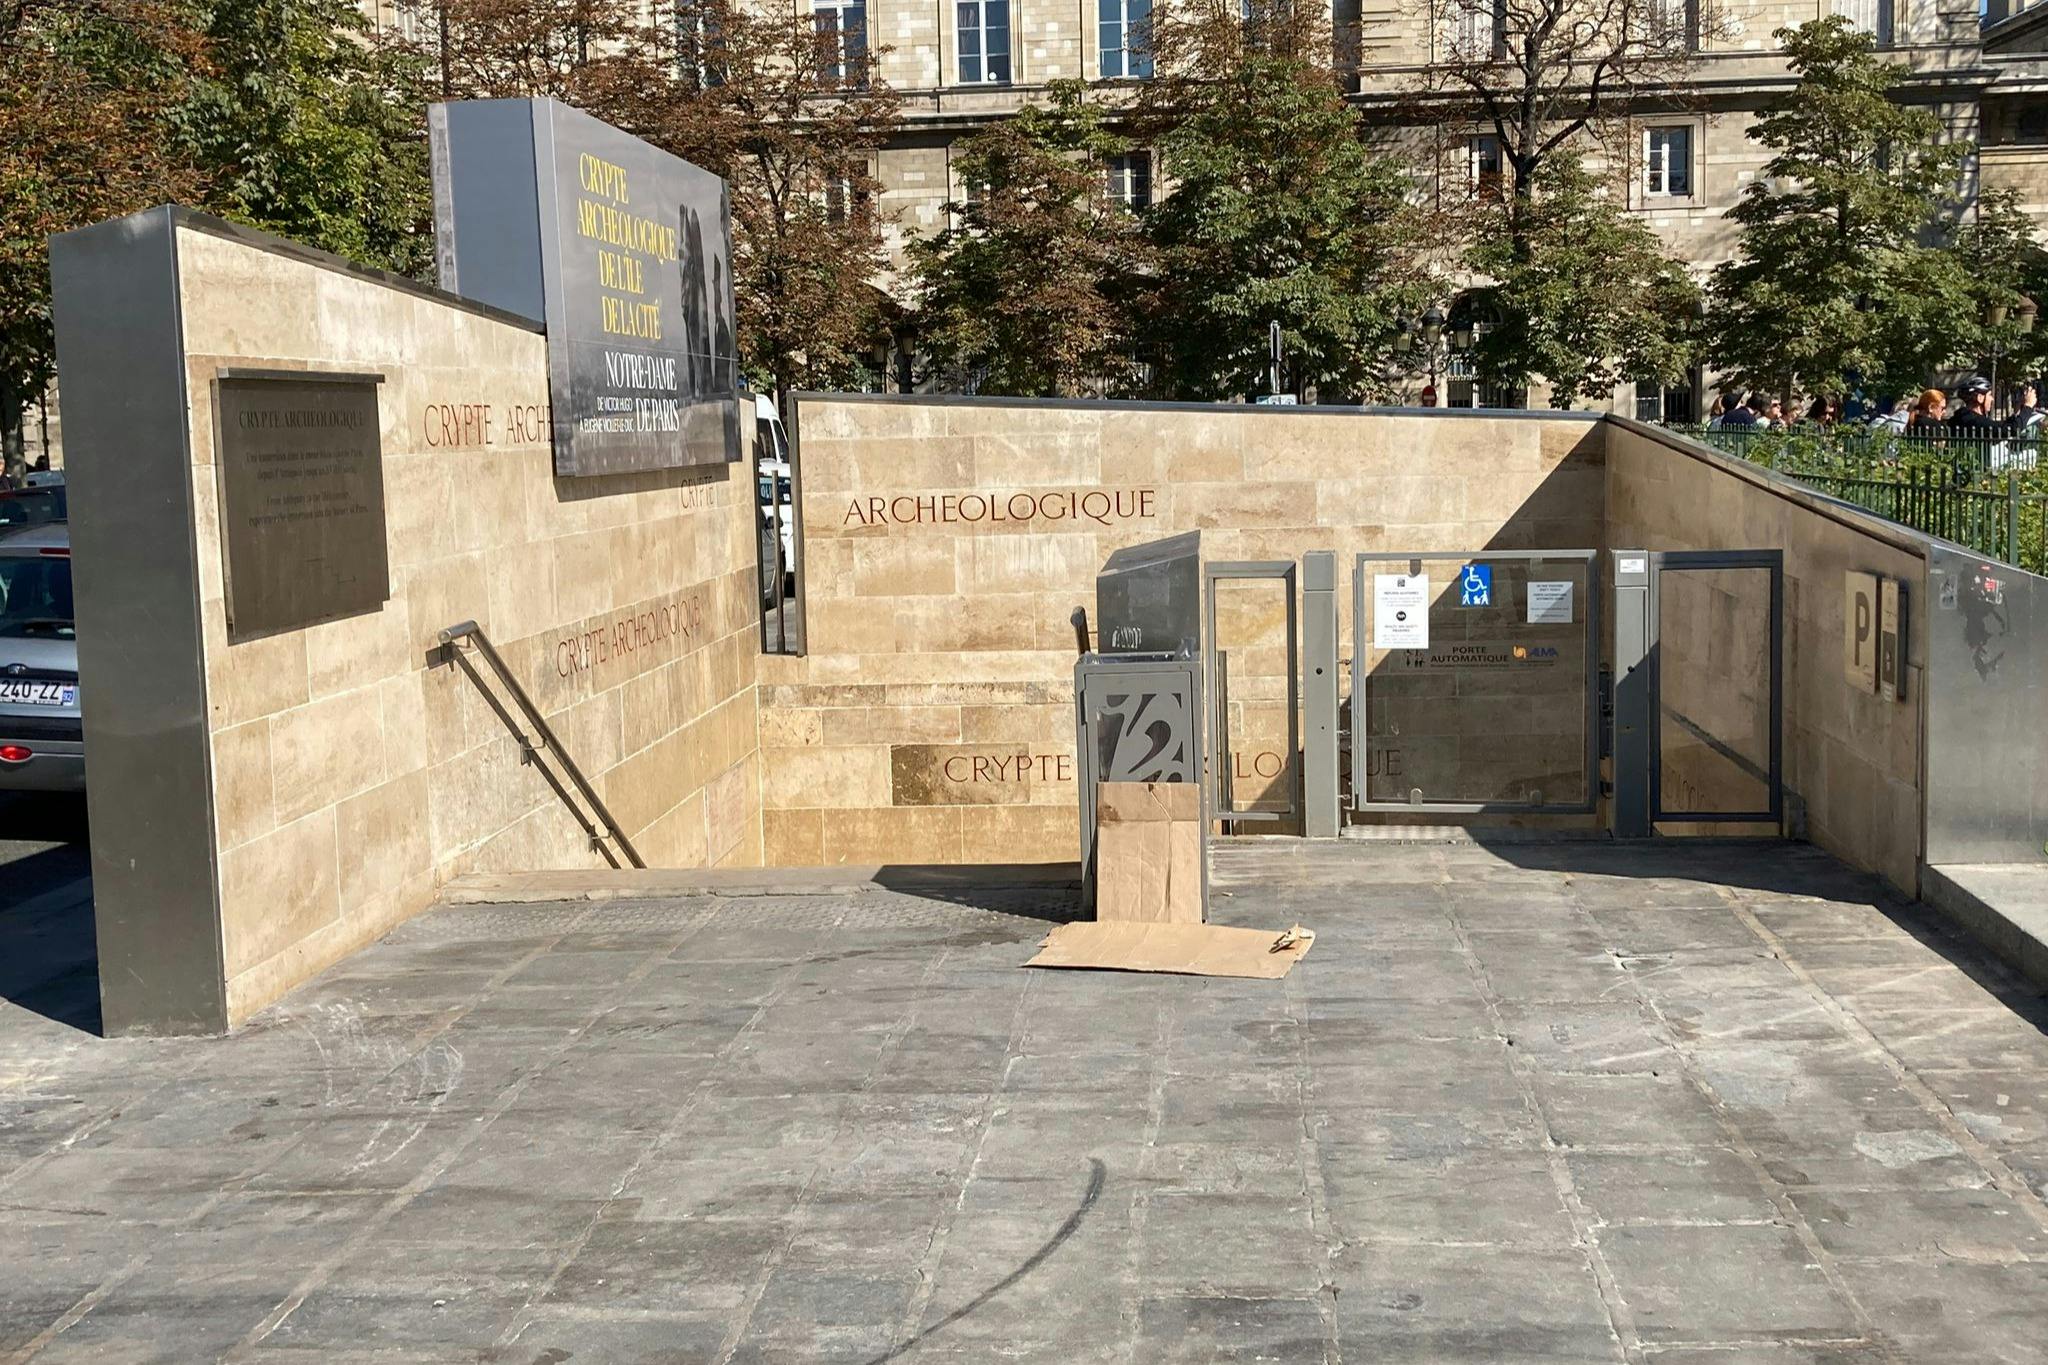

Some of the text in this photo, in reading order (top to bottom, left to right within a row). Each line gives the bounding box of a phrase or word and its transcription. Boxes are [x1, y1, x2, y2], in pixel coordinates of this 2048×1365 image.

[579, 152, 630, 205] CRYPTE
[577, 198, 677, 265] ARCHÉOLOGIQUE
[599, 250, 617, 289] DE
[602, 296, 662, 340] DE LA CITÉ
[605, 351, 678, 391] NOTRE-DAME
[239, 410, 279, 429] CRYPTE
[424, 404, 552, 447] CRYPTE ARCHE
[635, 398, 680, 432] DE PARIS
[681, 475, 714, 508] CRYPTE
[844, 490, 1155, 526] ARCHEOLOGIQUE
[556, 595, 701, 678] CRYPTE ARCHEOLOGIQUE
[1452, 646, 1487, 654] PORTE
[1431, 655, 1509, 663] AUTOMATIQUE
[944, 754, 1072, 783] CRYPTE
